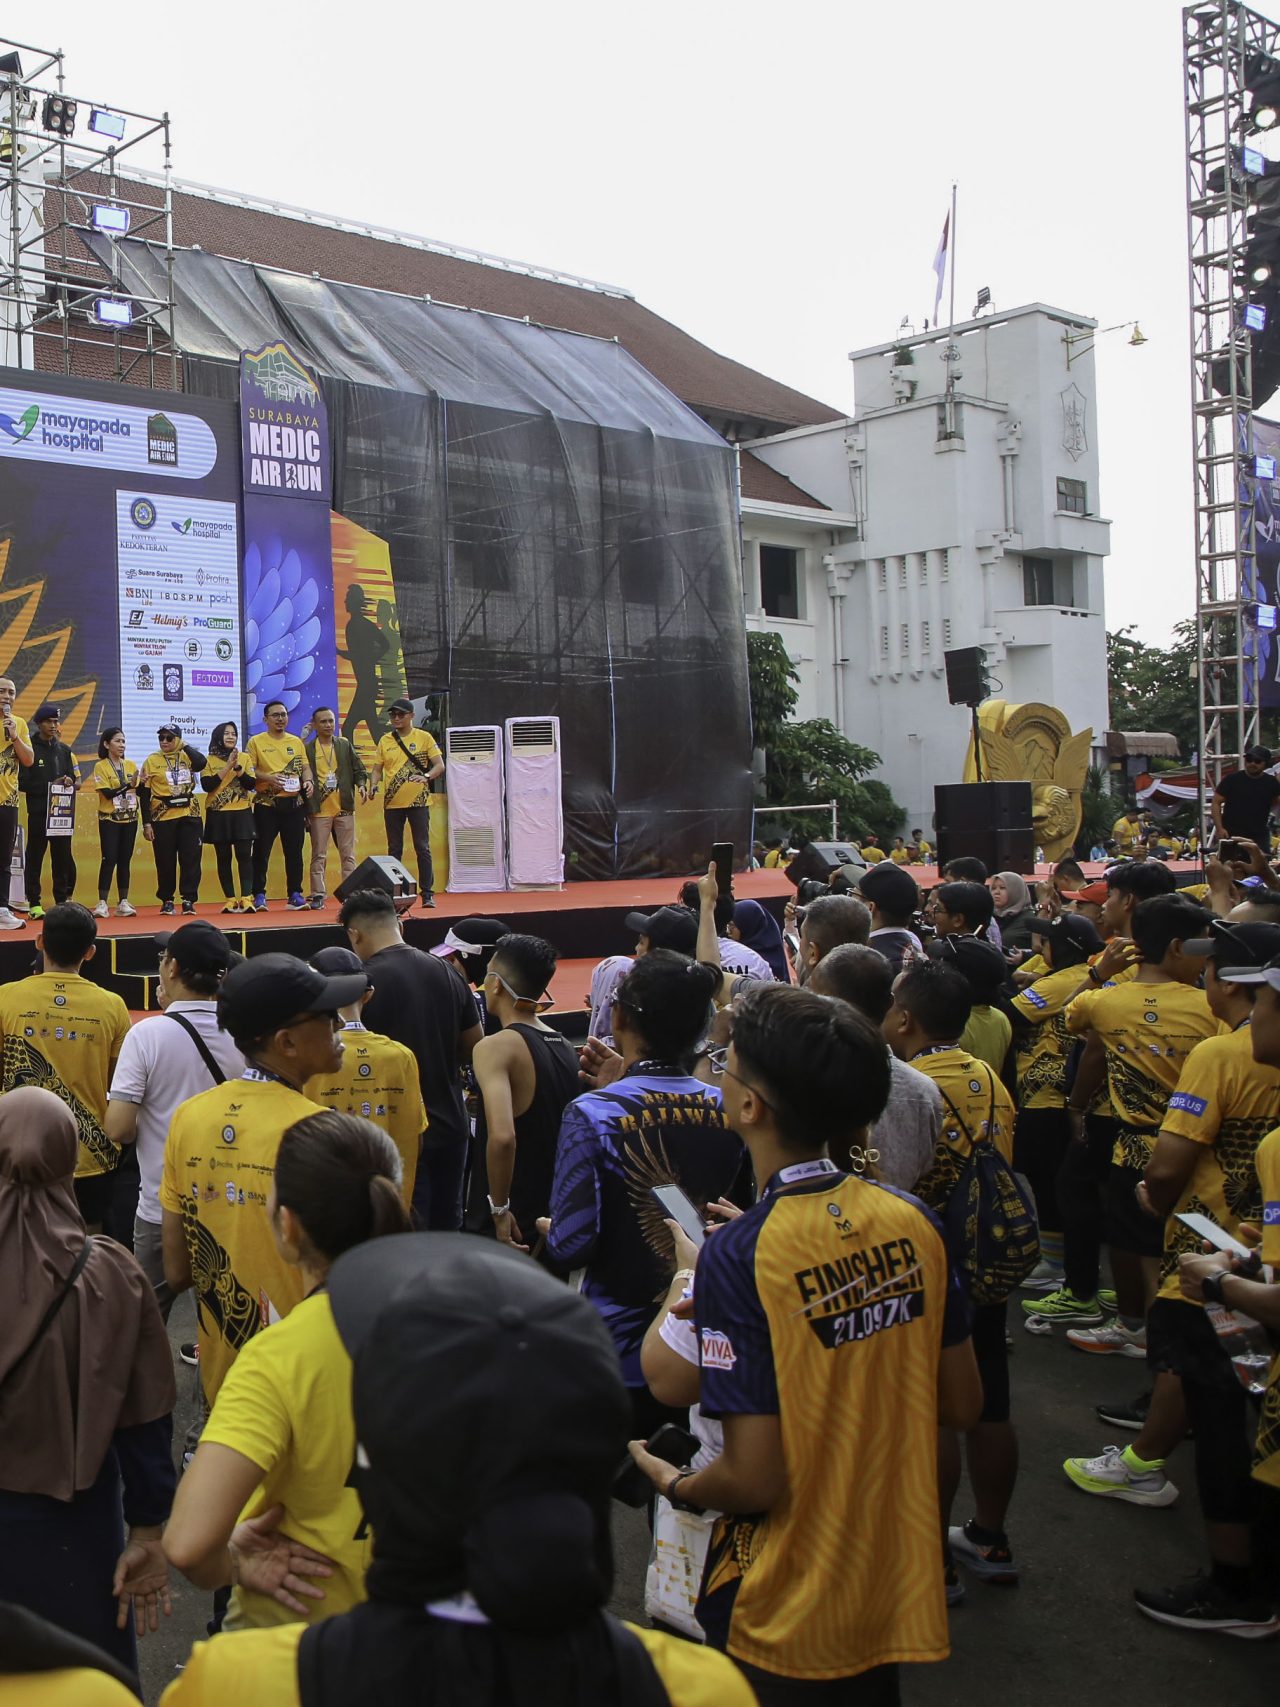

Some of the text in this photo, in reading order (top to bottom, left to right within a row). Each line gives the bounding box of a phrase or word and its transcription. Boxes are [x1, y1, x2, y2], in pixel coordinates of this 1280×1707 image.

[41, 410, 131, 436] mayapada
[248, 407, 319, 429] SURABAYA
[42, 428, 104, 453] hospital
[150, 439, 175, 453] MEDIC
[249, 421, 320, 463] MEDIC
[250, 458, 322, 492] AIR RUN
[192, 520, 233, 532] mayapada
[119, 541, 168, 552] KEDOKTERAN
[138, 569, 156, 577] Suara
[135, 588, 153, 600] BNI
[150, 613, 189, 631] Helmig's
[193, 617, 233, 629] ProGuard
[170, 715, 197, 726] Proudly
[196, 728, 208, 736] by:
[793, 1237, 923, 1318] FINISHER
[833, 1293, 915, 1347] 21.097K
